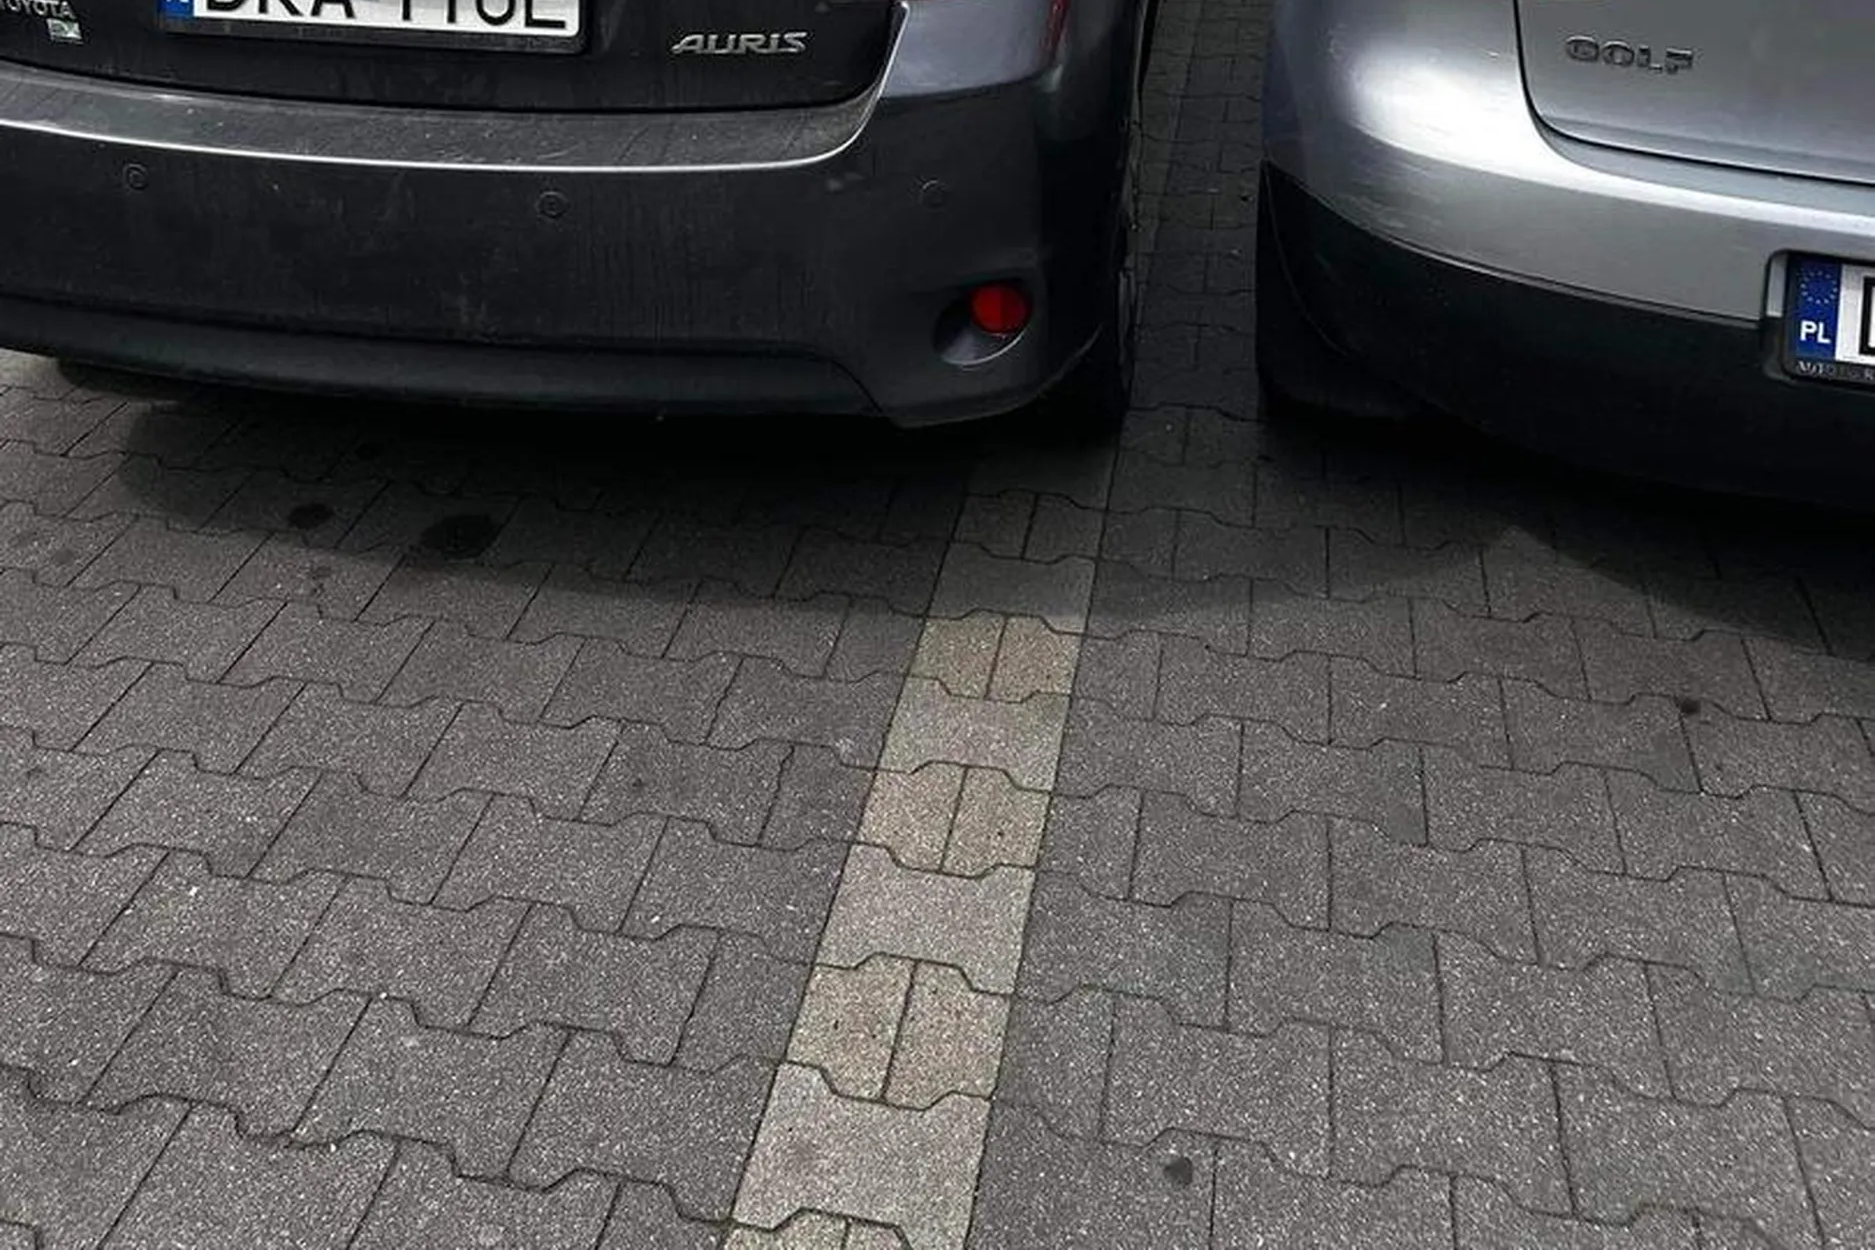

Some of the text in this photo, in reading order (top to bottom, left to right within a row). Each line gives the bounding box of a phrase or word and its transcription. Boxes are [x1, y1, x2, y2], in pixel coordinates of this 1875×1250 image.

[671, 32, 808, 54] AURIS
[1565, 34, 1694, 75] GOLF
[1799, 321, 1831, 344] PL
